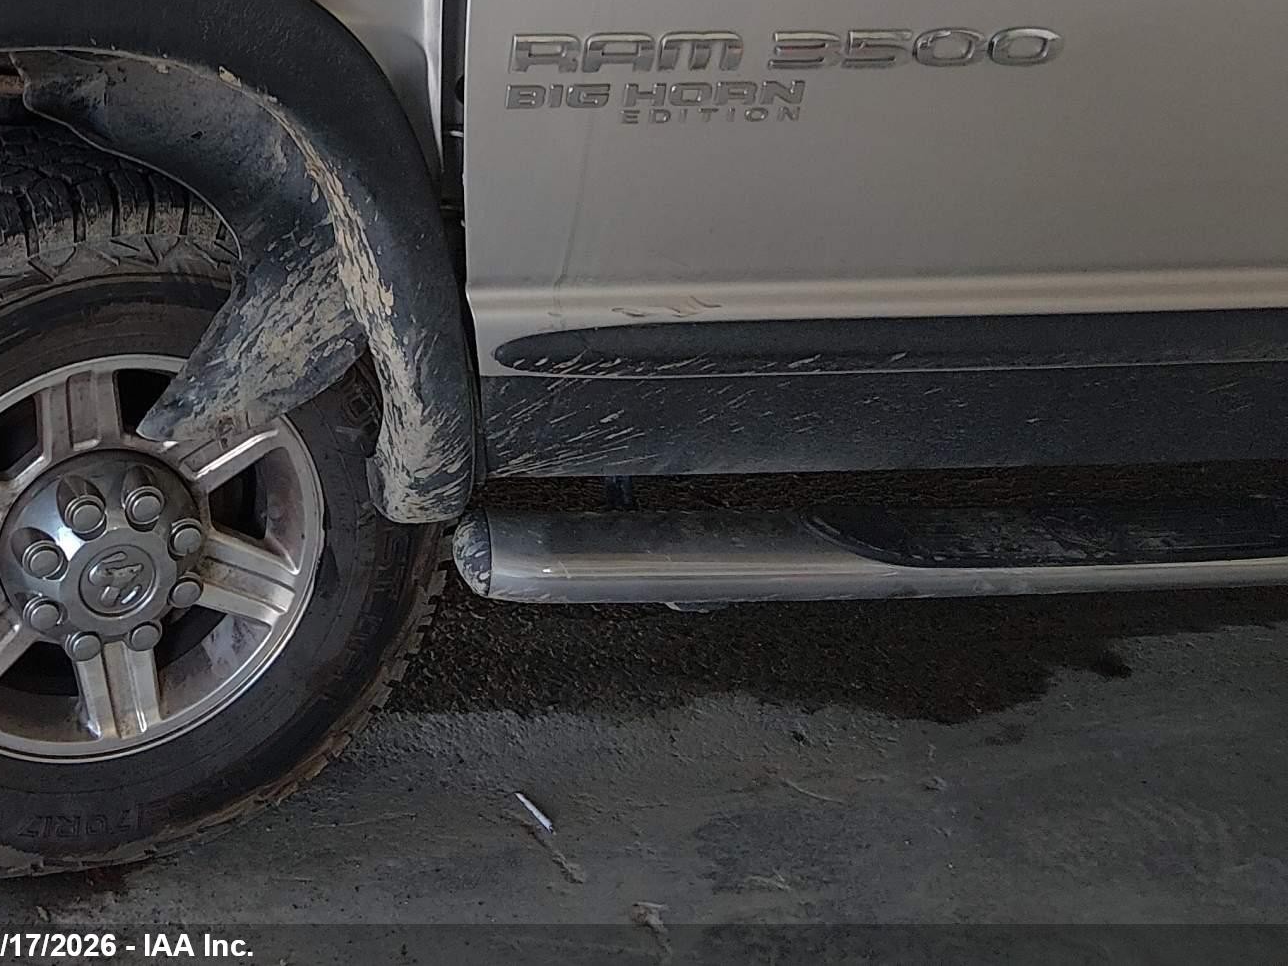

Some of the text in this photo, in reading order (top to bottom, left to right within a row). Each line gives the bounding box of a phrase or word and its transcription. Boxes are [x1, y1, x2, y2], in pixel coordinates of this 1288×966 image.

[508, 27, 1065, 74] RAM 3500
[505, 80, 807, 109] BIG HORN
[620, 107, 802, 125] EDITION
